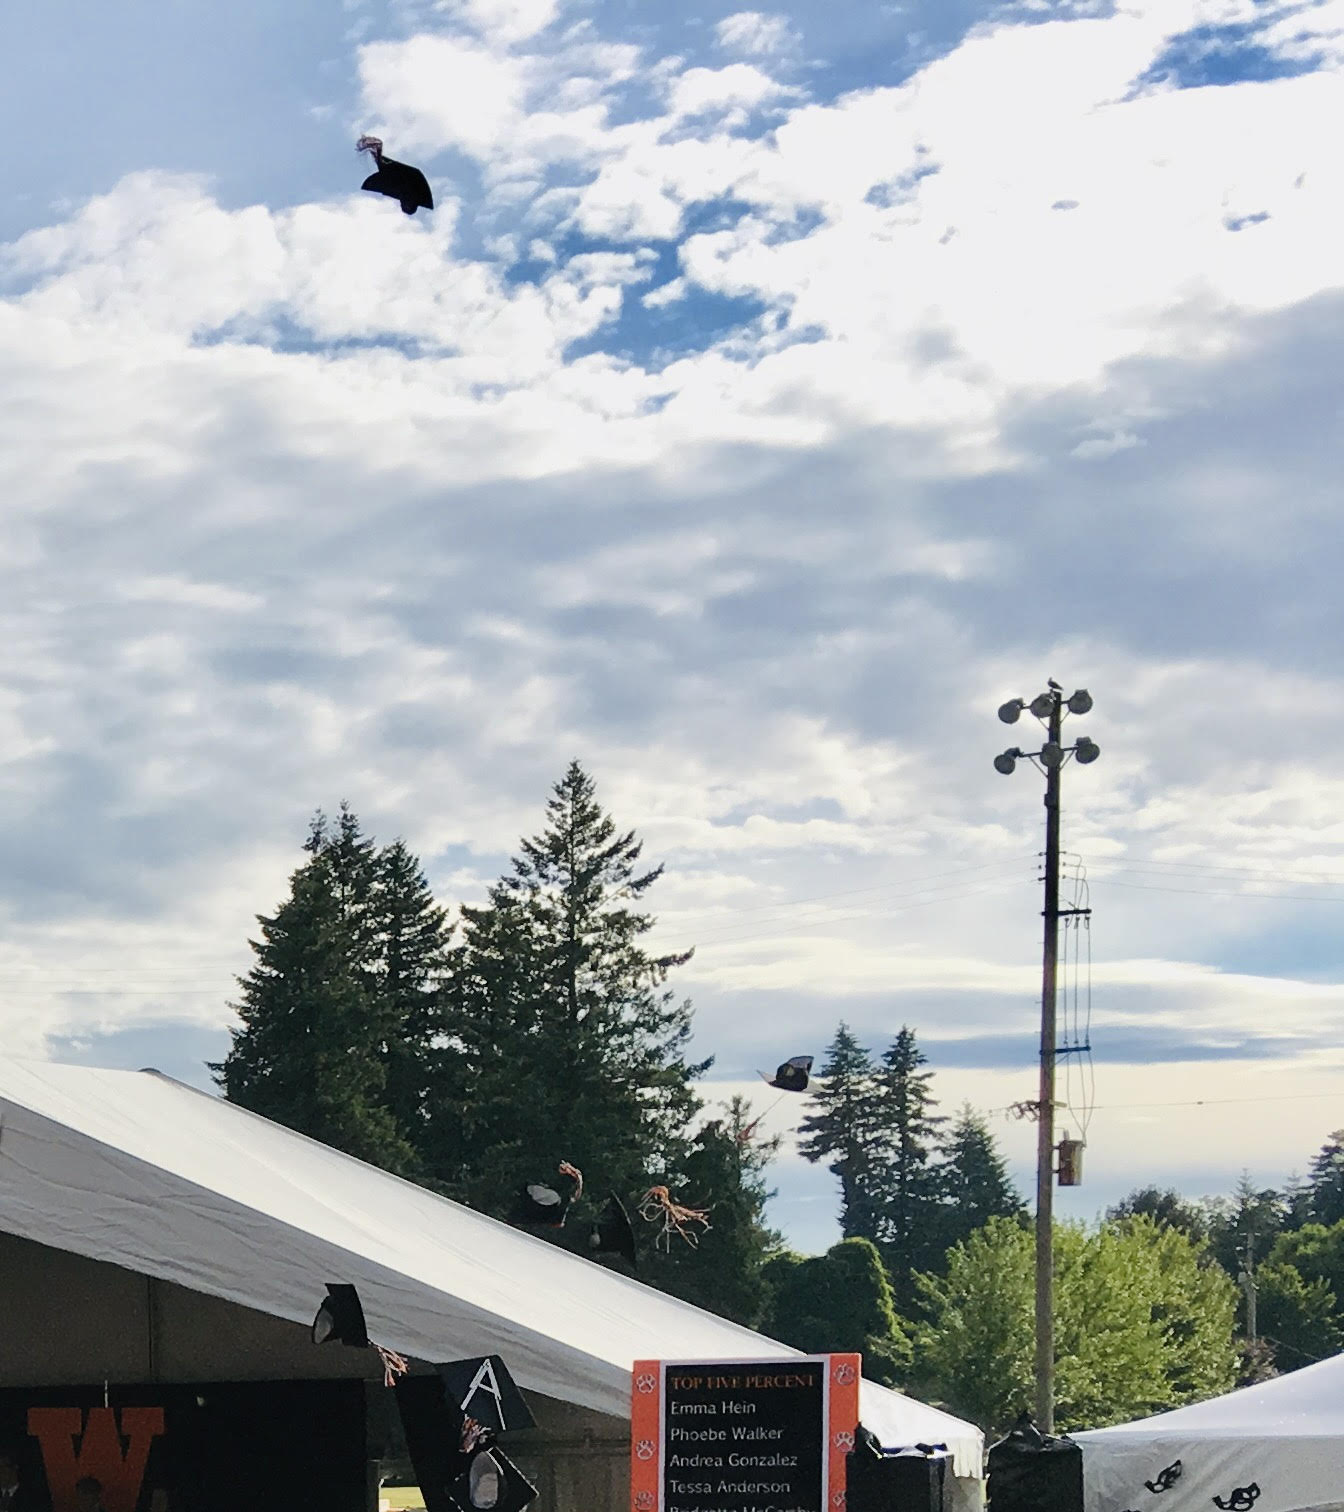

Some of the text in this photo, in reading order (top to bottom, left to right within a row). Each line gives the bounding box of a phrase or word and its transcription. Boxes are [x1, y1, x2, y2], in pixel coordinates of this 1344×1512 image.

[671, 1375, 814, 1390] TOP FIVE PERCENT
[671, 1401, 756, 1415] Emma Hein
[670, 1427, 784, 1441] Phoebe Walker
[669, 1453, 798, 1467] Andrea Gonzalez
[669, 1480, 791, 1493] Tessa Anderson
